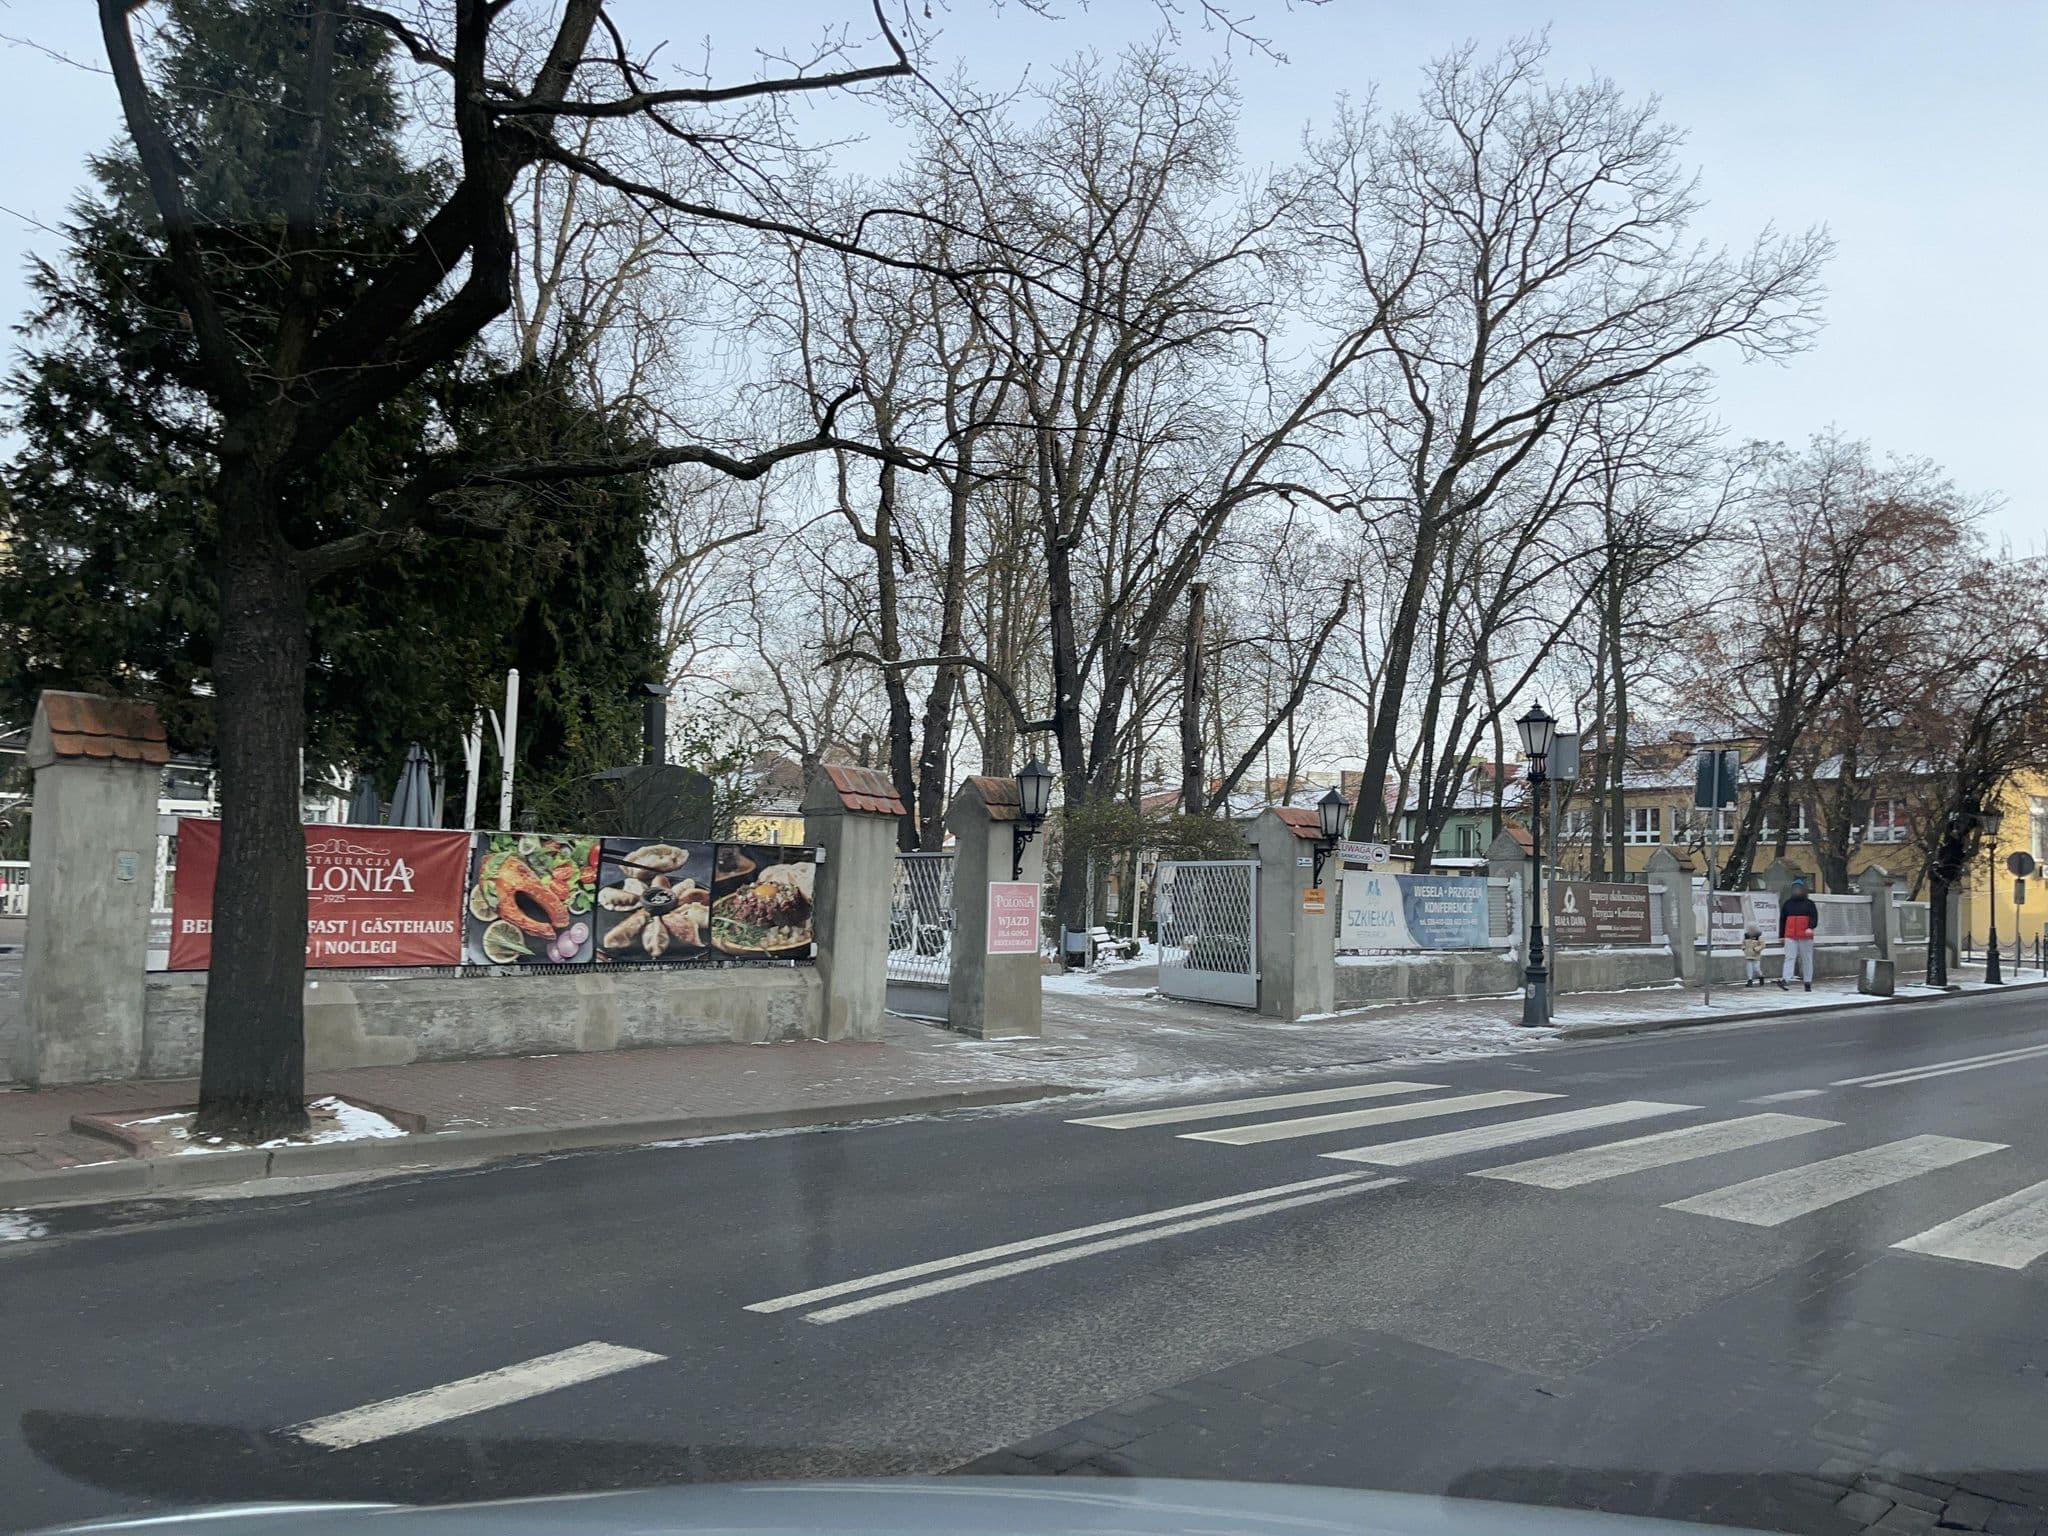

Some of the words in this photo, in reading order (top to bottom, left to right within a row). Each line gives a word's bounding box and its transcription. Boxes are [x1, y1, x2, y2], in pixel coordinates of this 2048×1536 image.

[1341, 844, 1371, 854] UWAGA
[305, 855, 391, 867] STAURACJA
[305, 858, 415, 892] LONIA
[1413, 885, 1444, 898] WESELA
[994, 895, 1035, 908] POLONIA
[1424, 902, 1473, 913] KONFERENCJE
[998, 916, 1029, 929] WJAZD
[1348, 910, 1396, 927] SZKIEŁKA
[361, 917, 454, 934] GÄSTEHAUS
[324, 940, 397, 955] NOCLEGI
